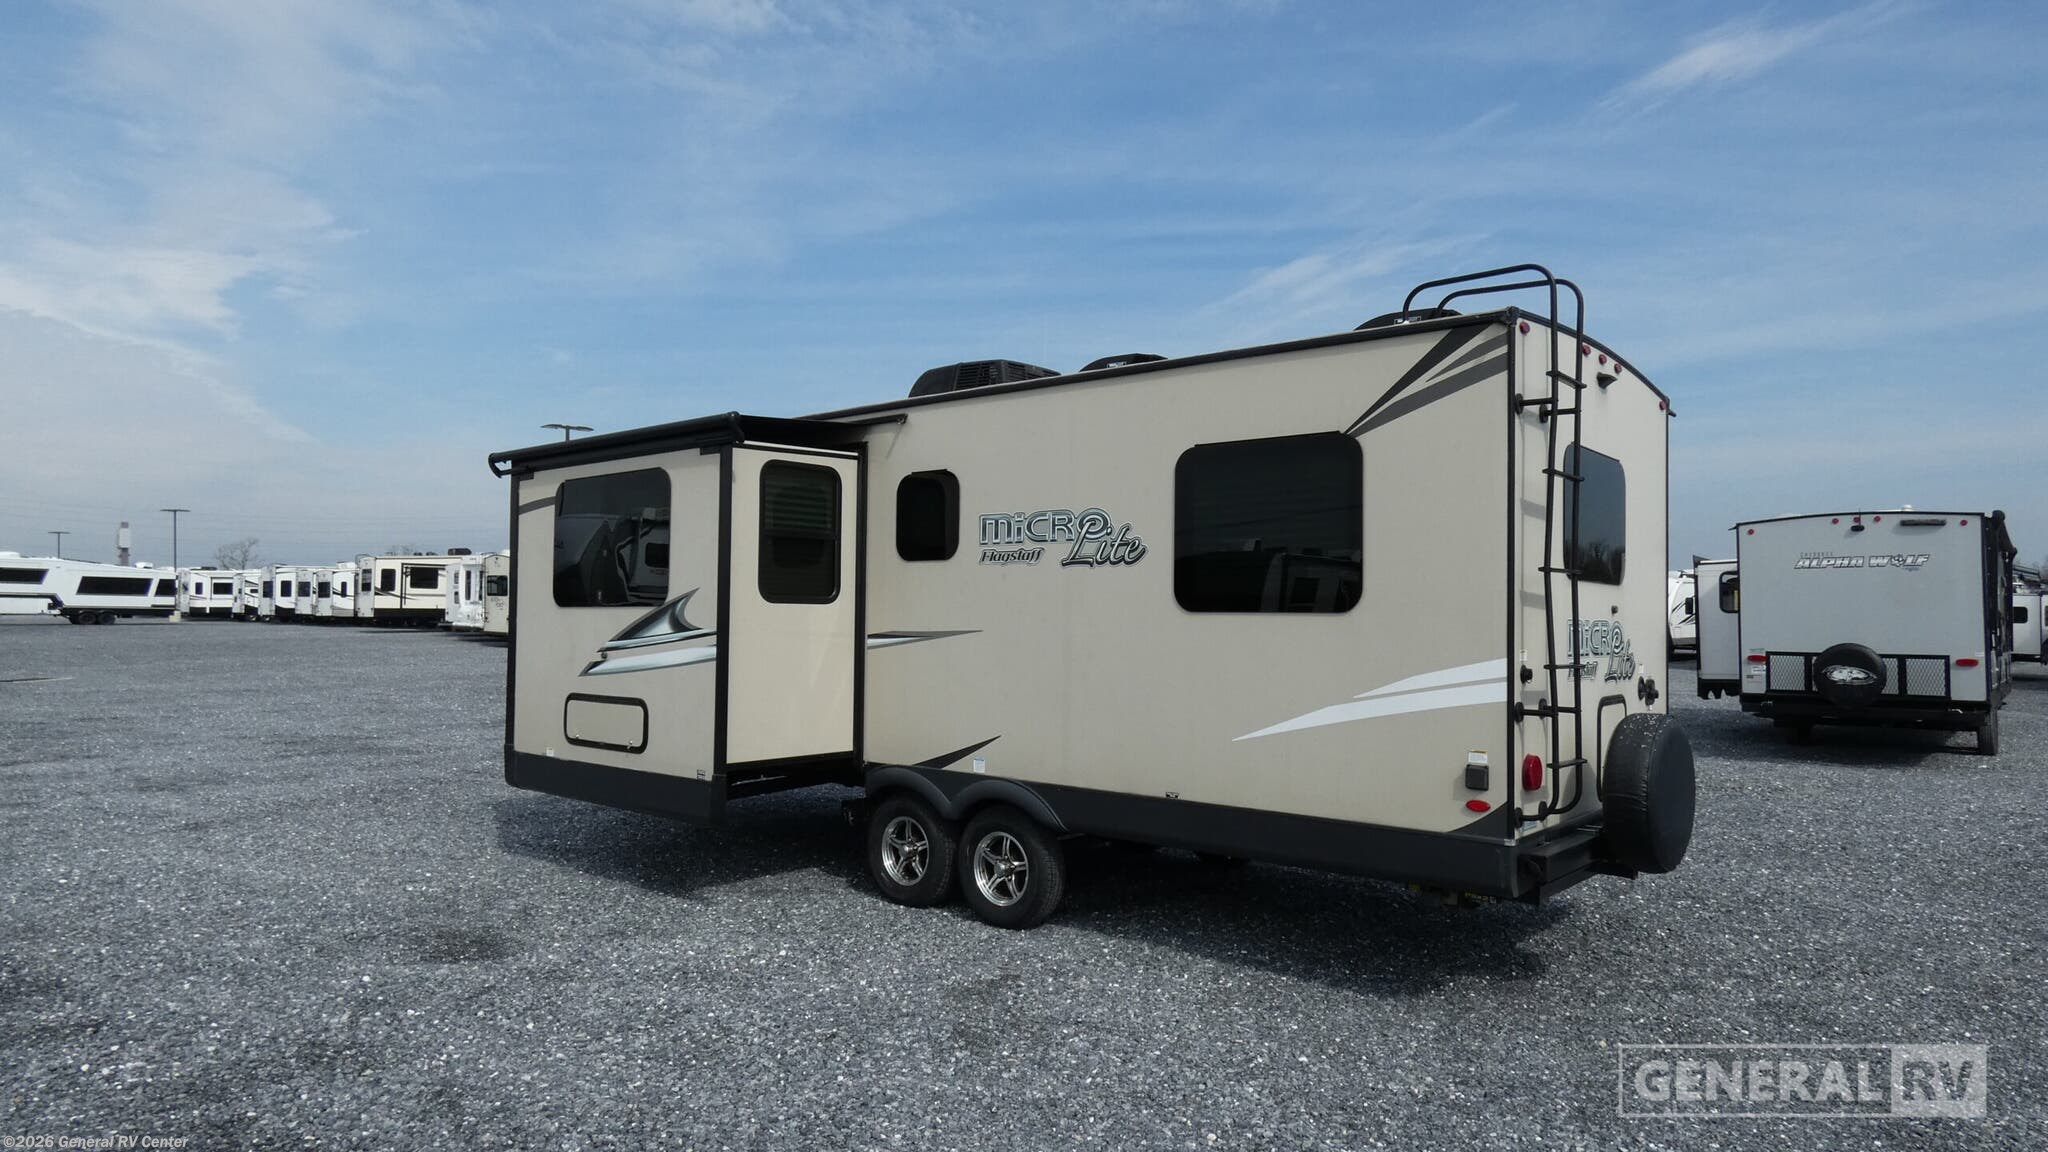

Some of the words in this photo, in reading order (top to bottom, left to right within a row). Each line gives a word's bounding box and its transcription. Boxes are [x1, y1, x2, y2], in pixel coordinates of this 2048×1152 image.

[1061, 520, 1148, 567] Lite
[980, 548, 1044, 566] Flagstaff
[1794, 556, 1865, 569] ALPHA
